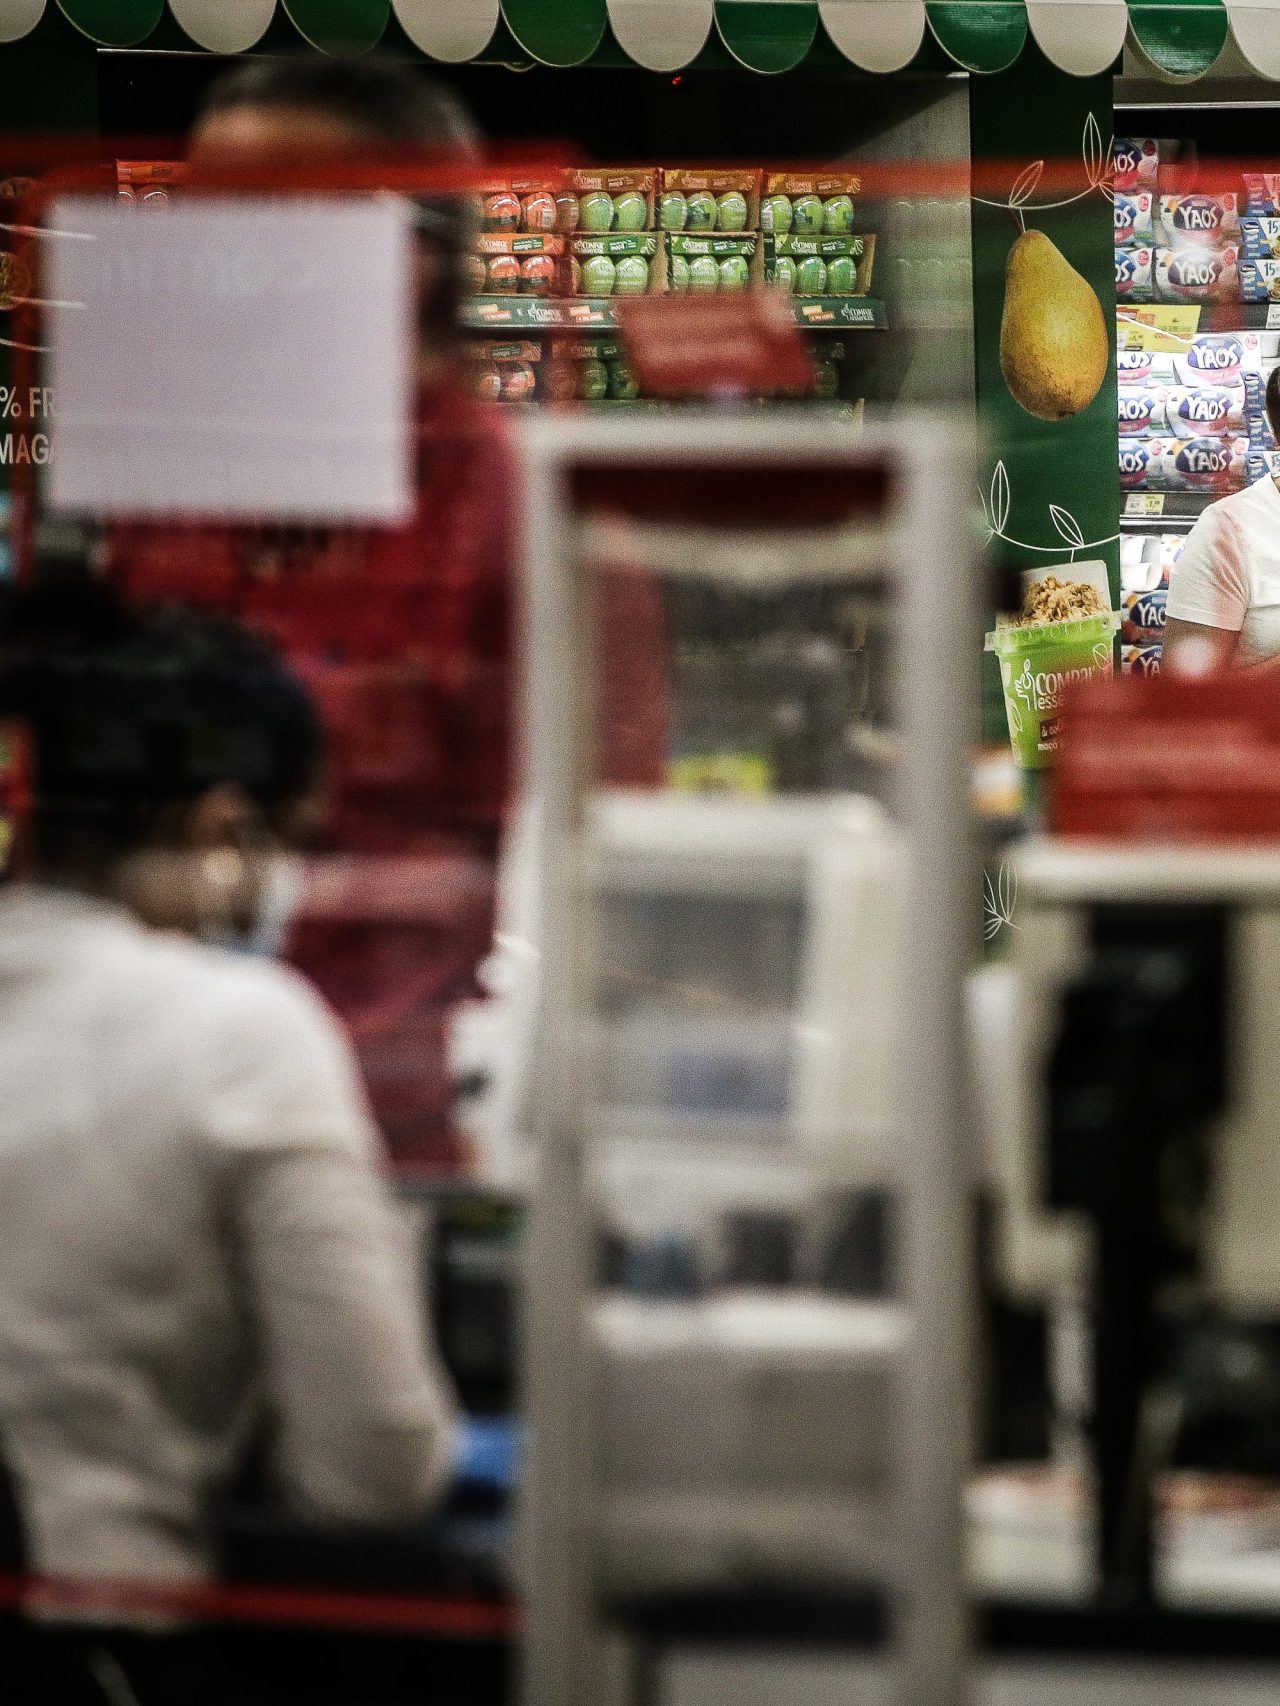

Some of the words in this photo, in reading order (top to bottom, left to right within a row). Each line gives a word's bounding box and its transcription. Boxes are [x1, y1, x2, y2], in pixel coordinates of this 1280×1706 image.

[1178, 205, 1218, 230] YAOS
[1267, 220, 1279, 234] 15
[1173, 260, 1217, 285] YAOS
[1264, 263, 1276, 276] 15
[1191, 343, 1241, 369] YAOS
[1118, 397, 1150, 420] AOS
[1186, 396, 1228, 420] YAOS
[1183, 448, 1228, 472] YAOS
[1137, 602, 1168, 626] YAO
